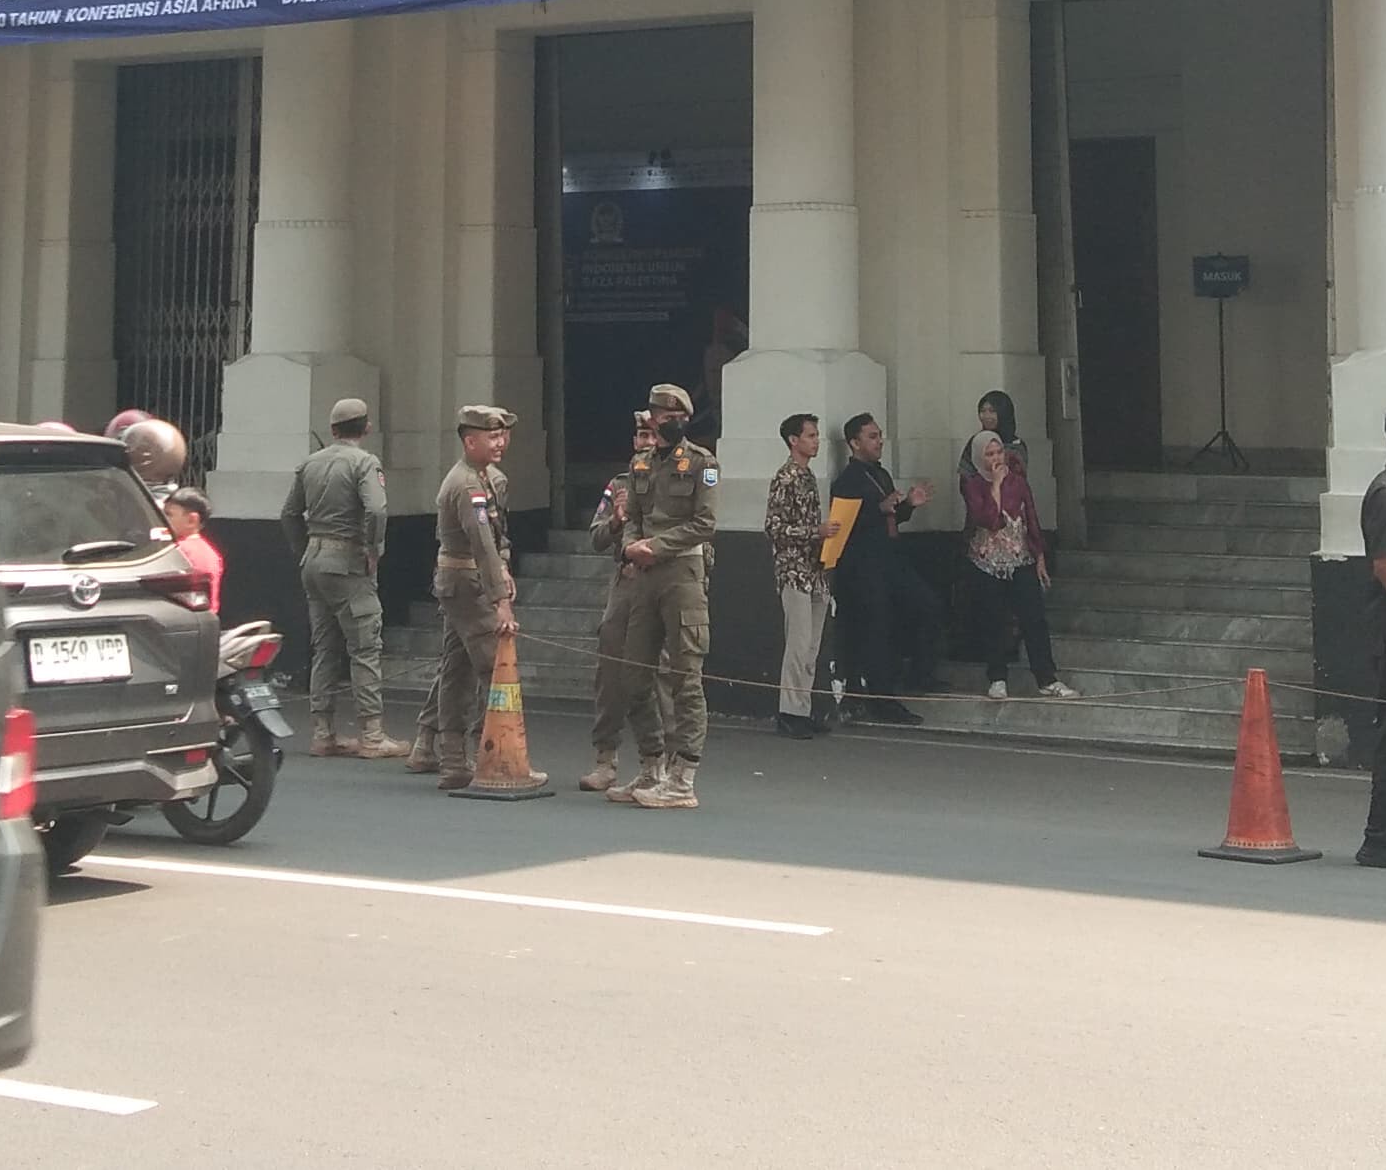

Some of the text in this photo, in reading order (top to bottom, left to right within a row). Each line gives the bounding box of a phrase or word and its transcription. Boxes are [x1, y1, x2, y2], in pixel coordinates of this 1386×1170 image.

[10, 10, 62, 27] TAHUN
[65, 2, 160, 24] KONFERENSI
[1202, 270, 1243, 282] MASUK
